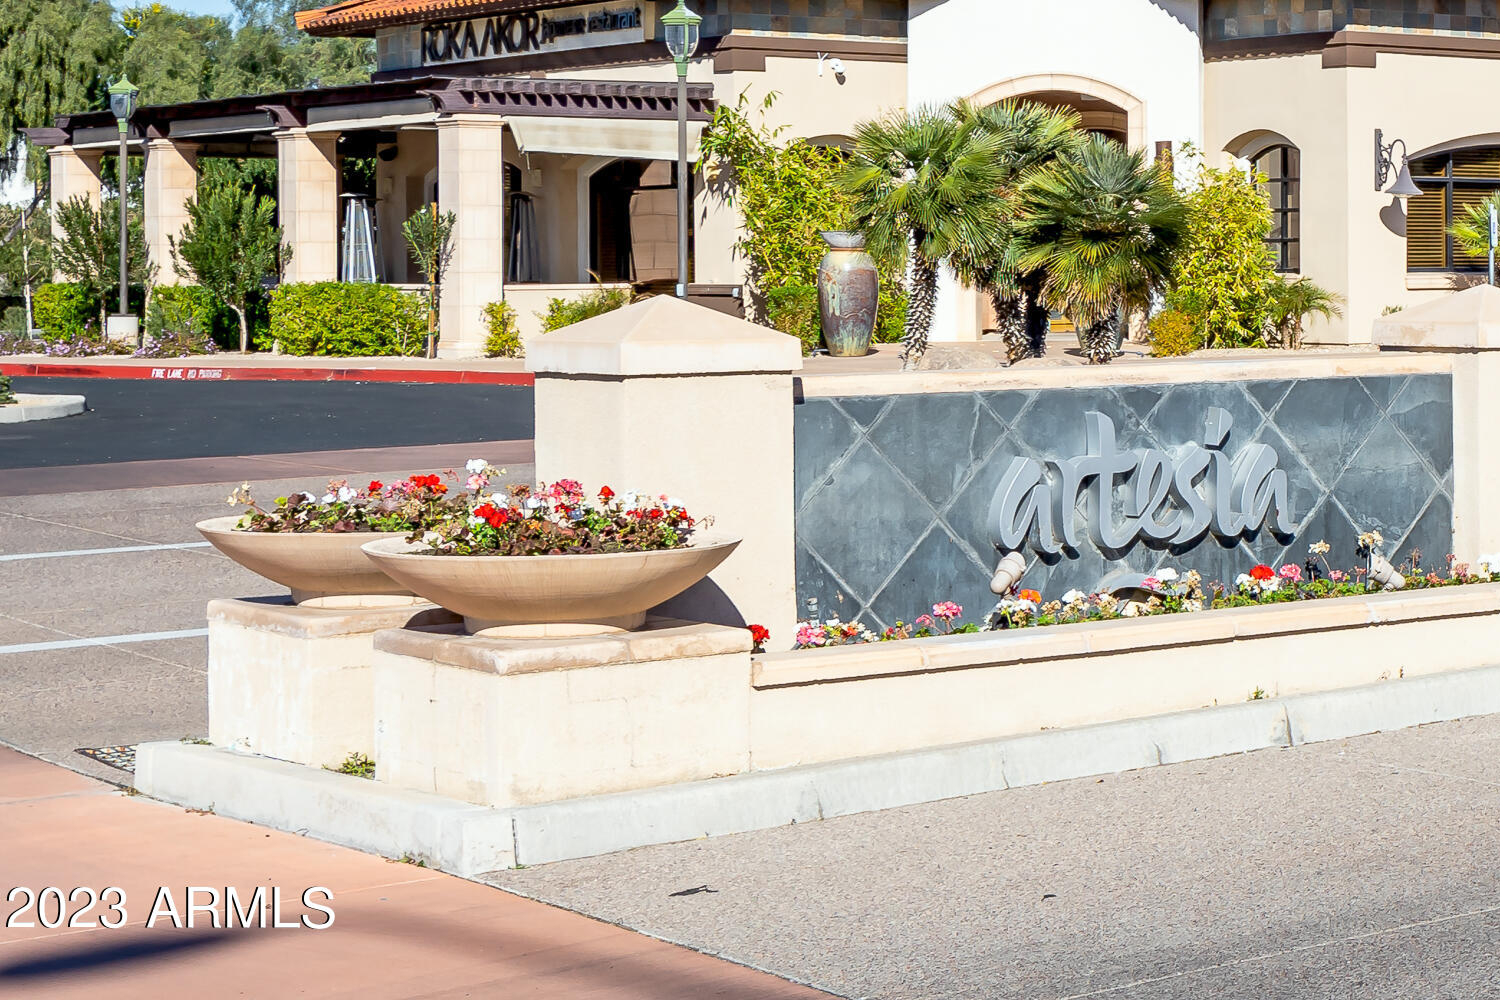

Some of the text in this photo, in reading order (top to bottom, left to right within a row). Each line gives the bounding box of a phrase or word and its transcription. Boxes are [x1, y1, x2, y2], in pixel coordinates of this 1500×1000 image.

[421, 20, 480, 64] ROKA
[479, 12, 541, 57] AKOR
[151, 368, 166, 379] FIRE
[987, 406, 1300, 555] artesia
